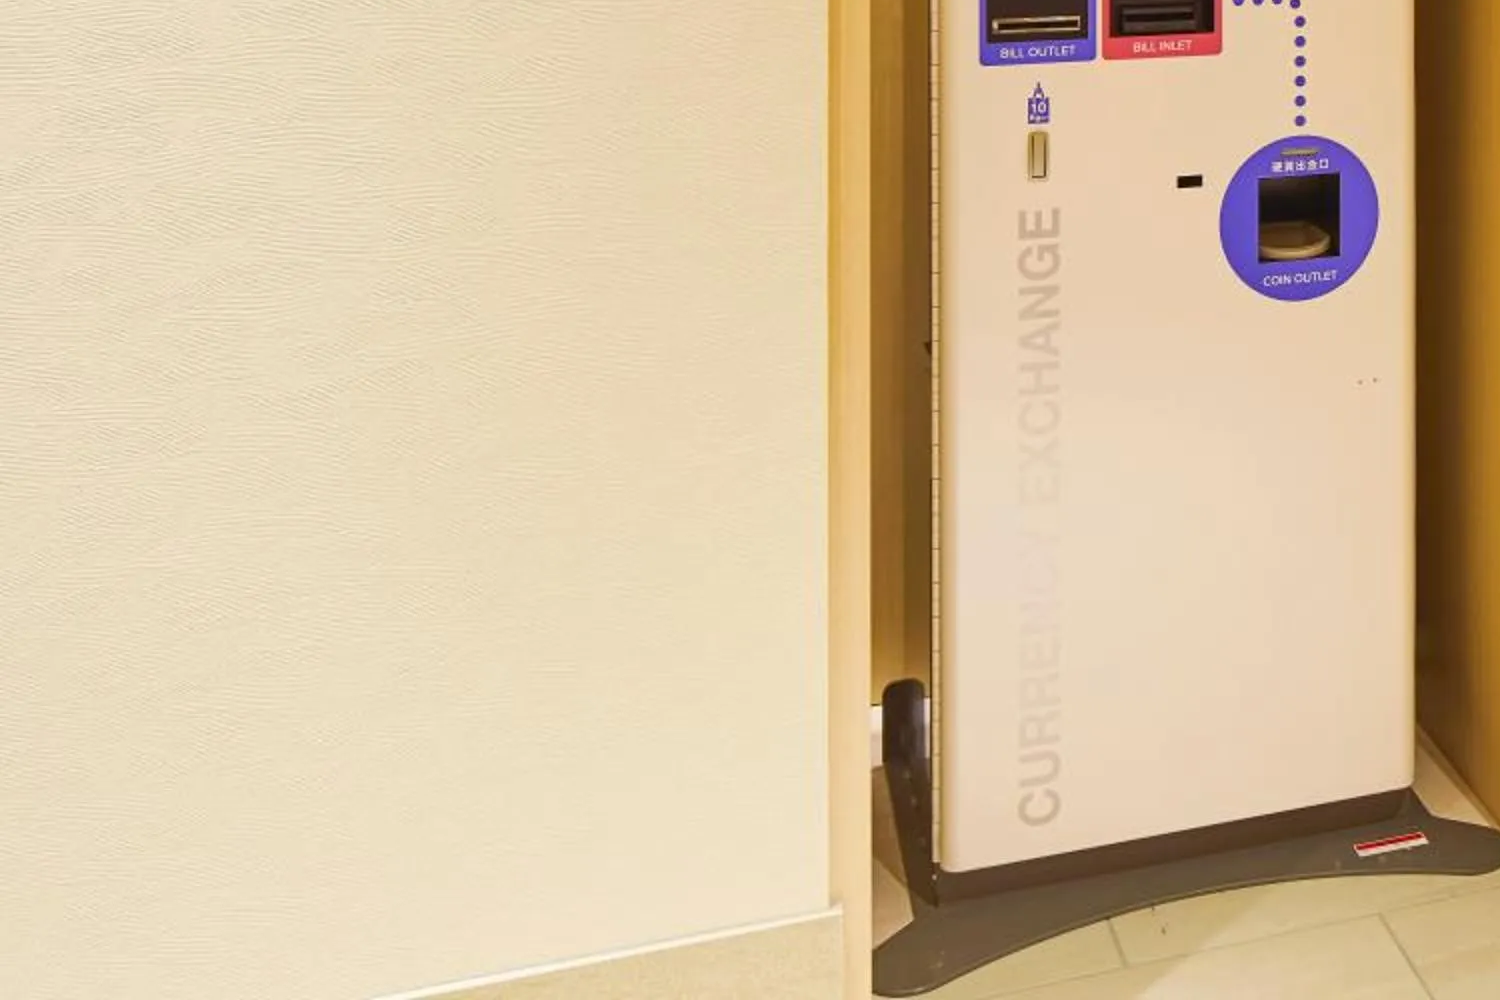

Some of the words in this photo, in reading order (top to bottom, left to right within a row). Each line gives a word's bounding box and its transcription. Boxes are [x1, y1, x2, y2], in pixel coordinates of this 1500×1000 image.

[1000, 46, 1025, 59] BILL
[1028, 44, 1077, 58] OUTLET
[1132, 41, 1156, 54] BILL
[1158, 39, 1194, 53] INLET
[1263, 271, 1292, 287] COIN
[1294, 269, 1339, 285] OUTLET
[1016, 206, 1062, 504] EXCHANGE
